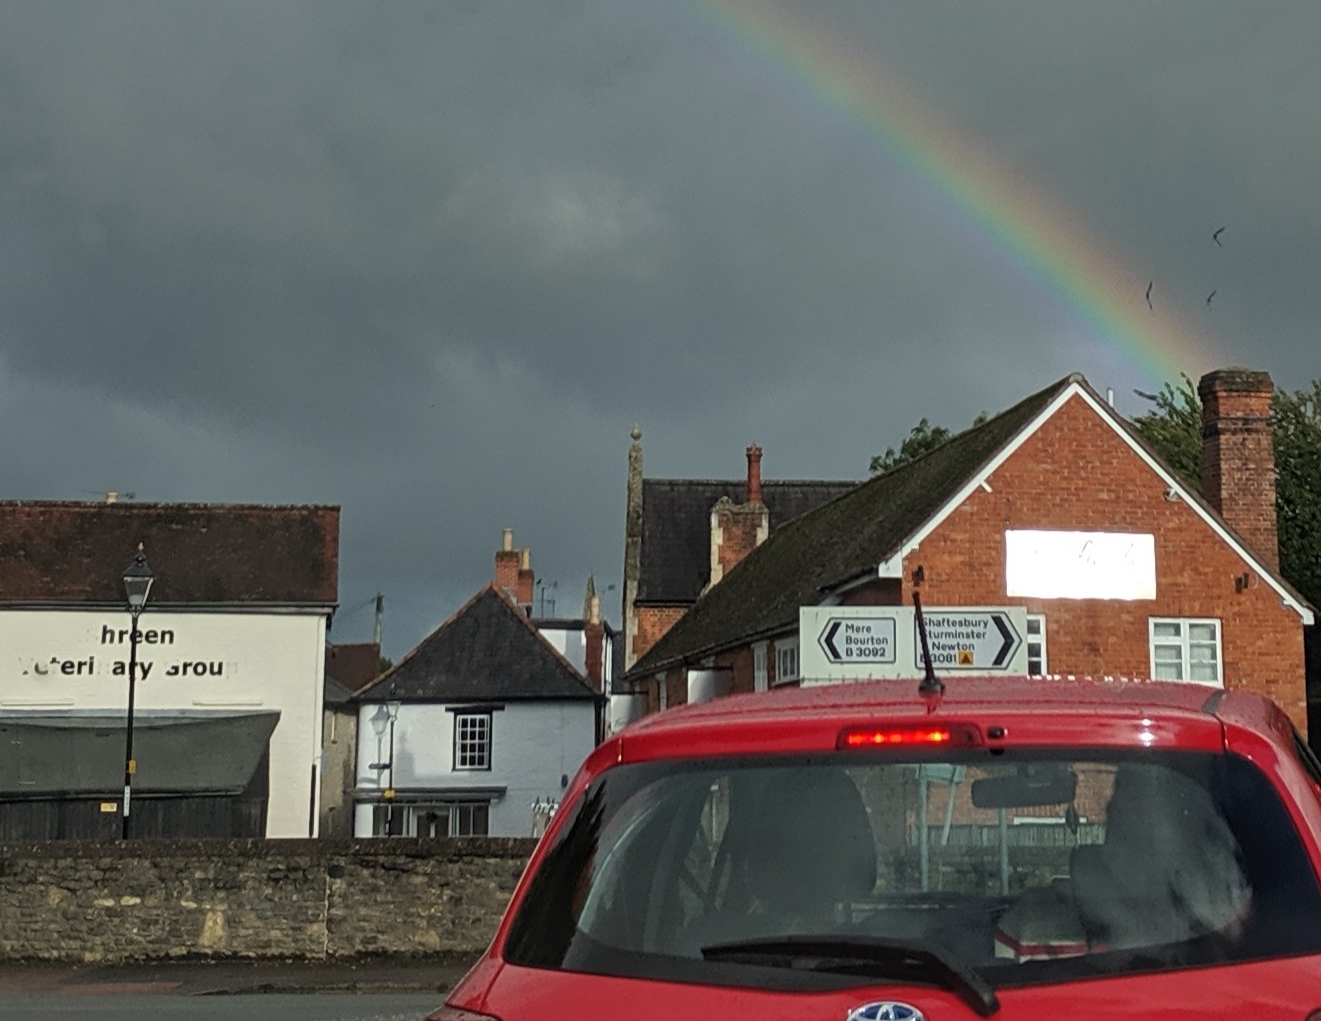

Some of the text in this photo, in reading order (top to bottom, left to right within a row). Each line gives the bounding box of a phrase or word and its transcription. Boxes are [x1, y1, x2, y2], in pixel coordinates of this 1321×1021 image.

[845, 623, 872, 634] Mere
[98, 624, 175, 645] hreen
[845, 635, 889, 646] Bourton
[931, 641, 976, 652] Newton
[845, 647, 886, 658] B 3092
